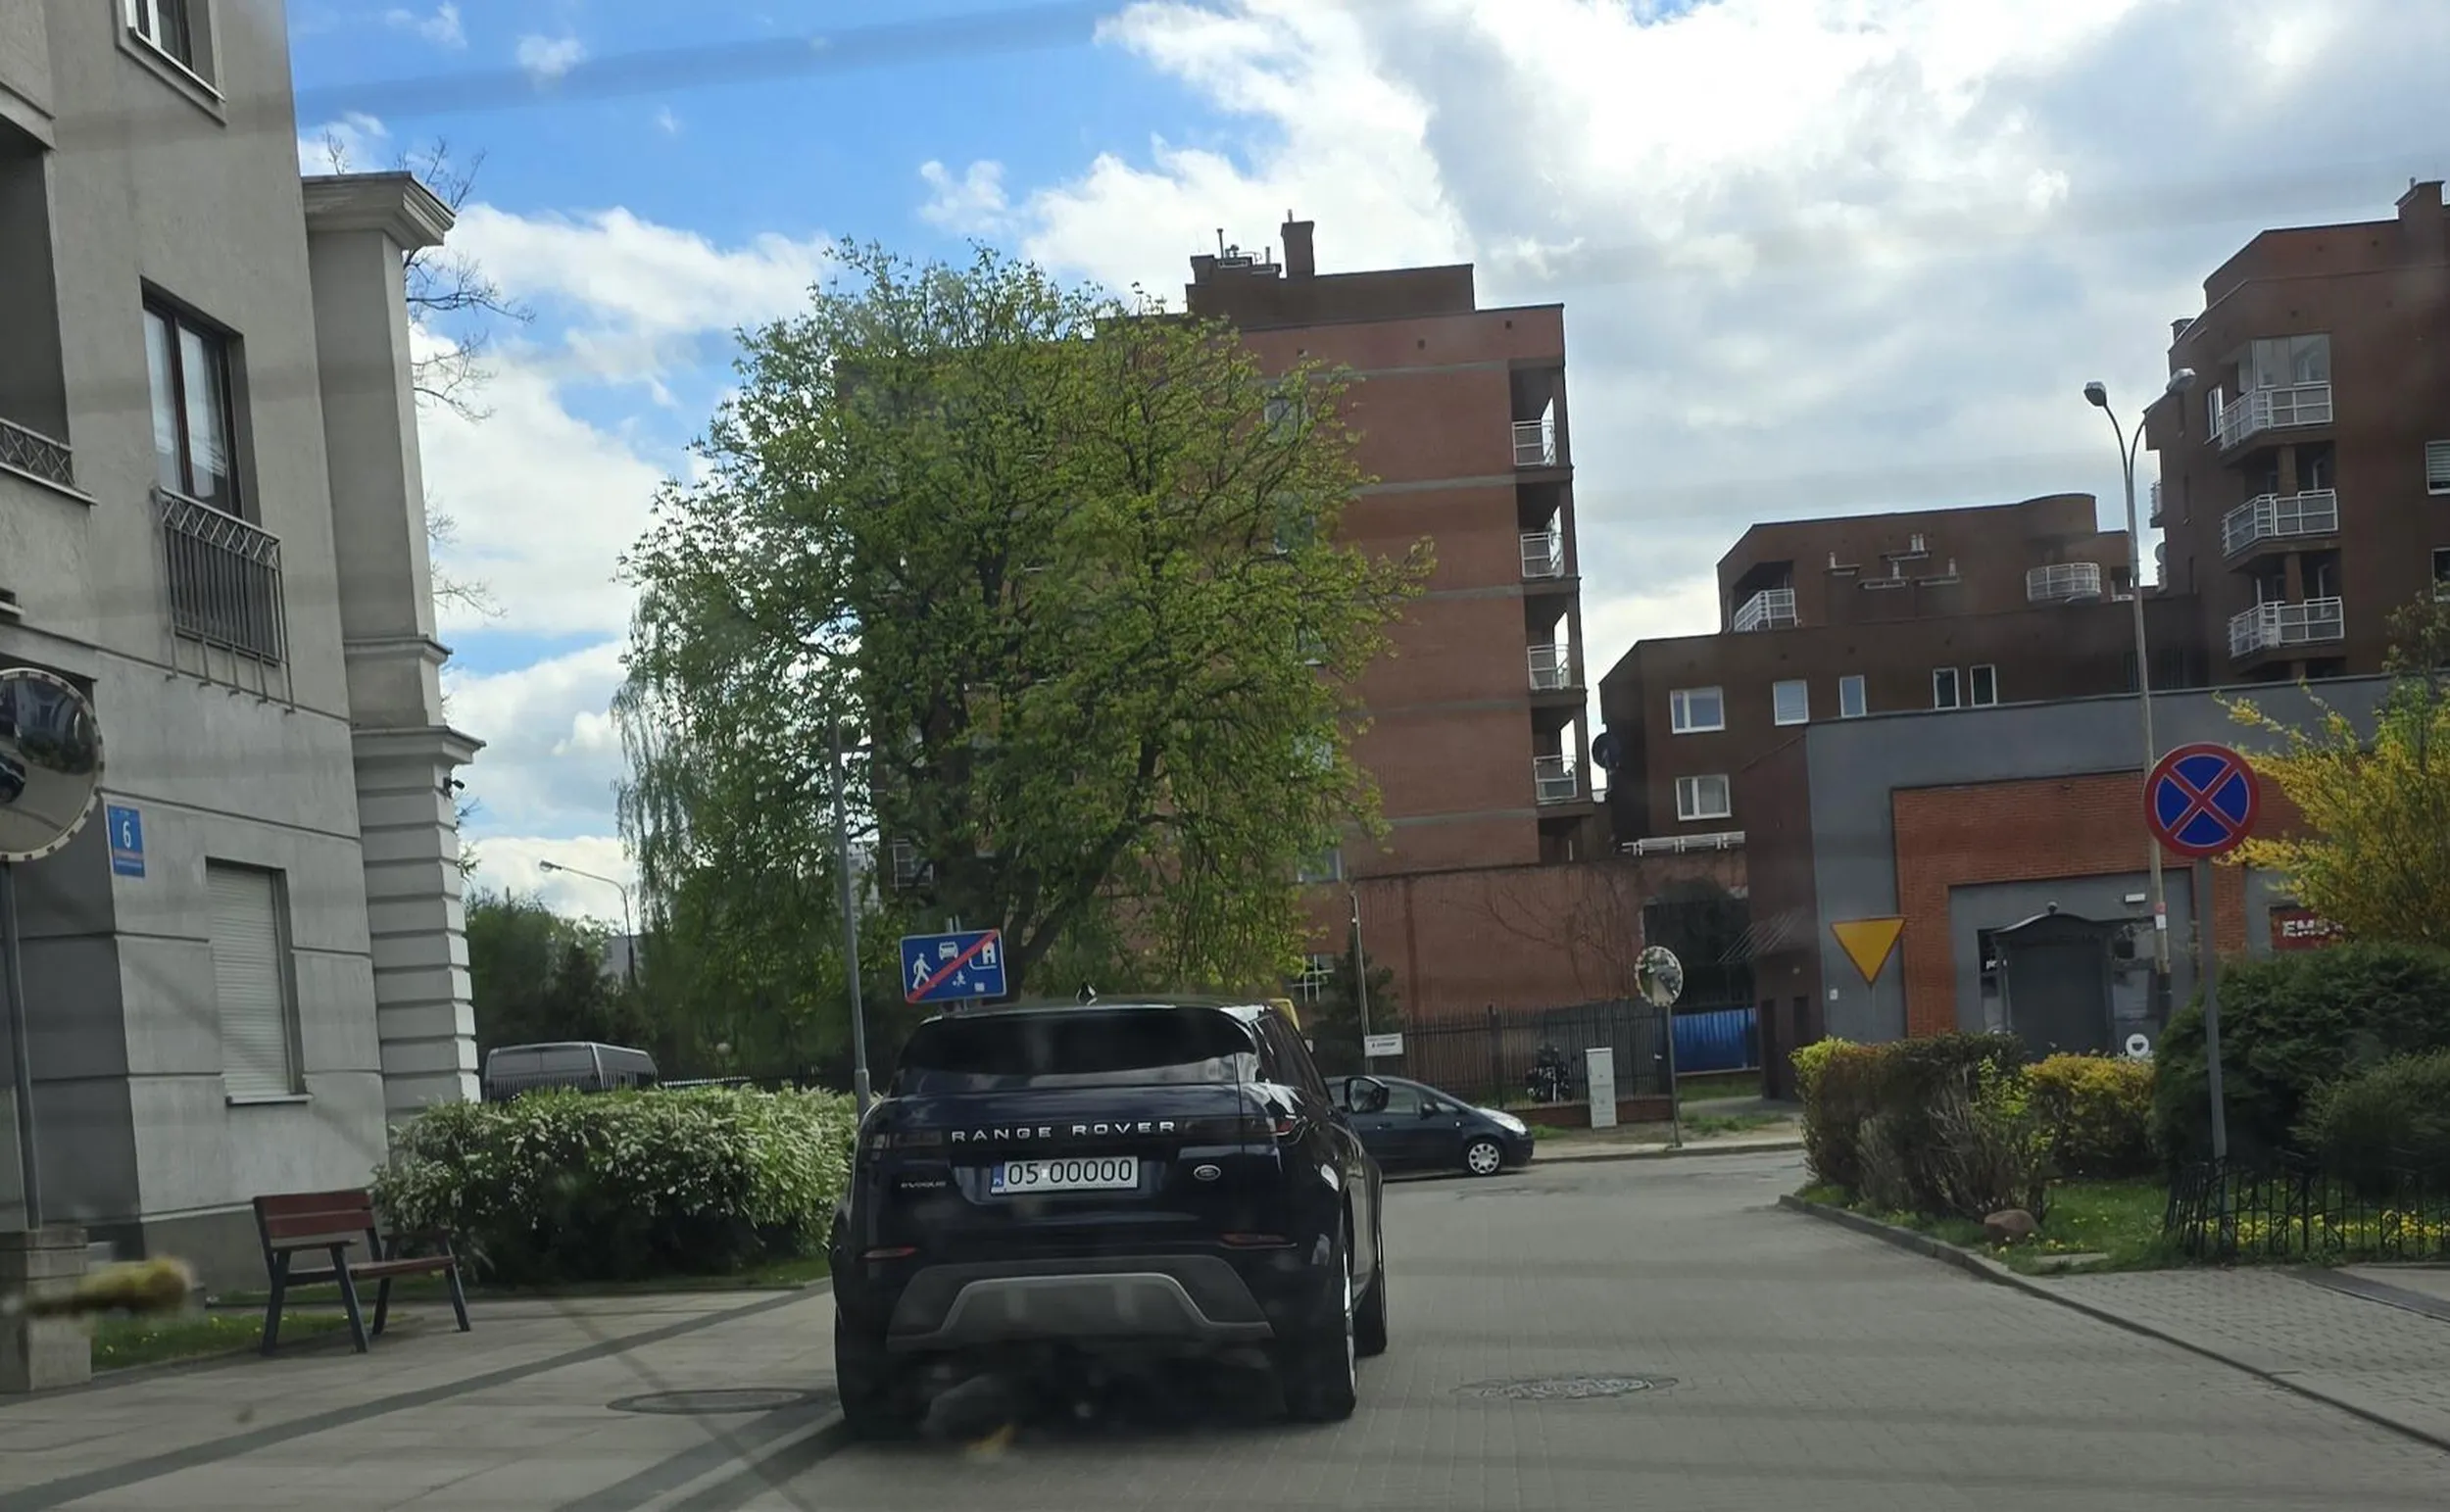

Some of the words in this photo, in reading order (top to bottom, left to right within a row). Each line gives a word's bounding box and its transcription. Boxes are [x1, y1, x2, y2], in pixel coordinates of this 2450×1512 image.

[122, 819, 132, 850] 6
[951, 1126, 1053, 1144] RANGE
[1071, 1121, 1176, 1137] ROVER
